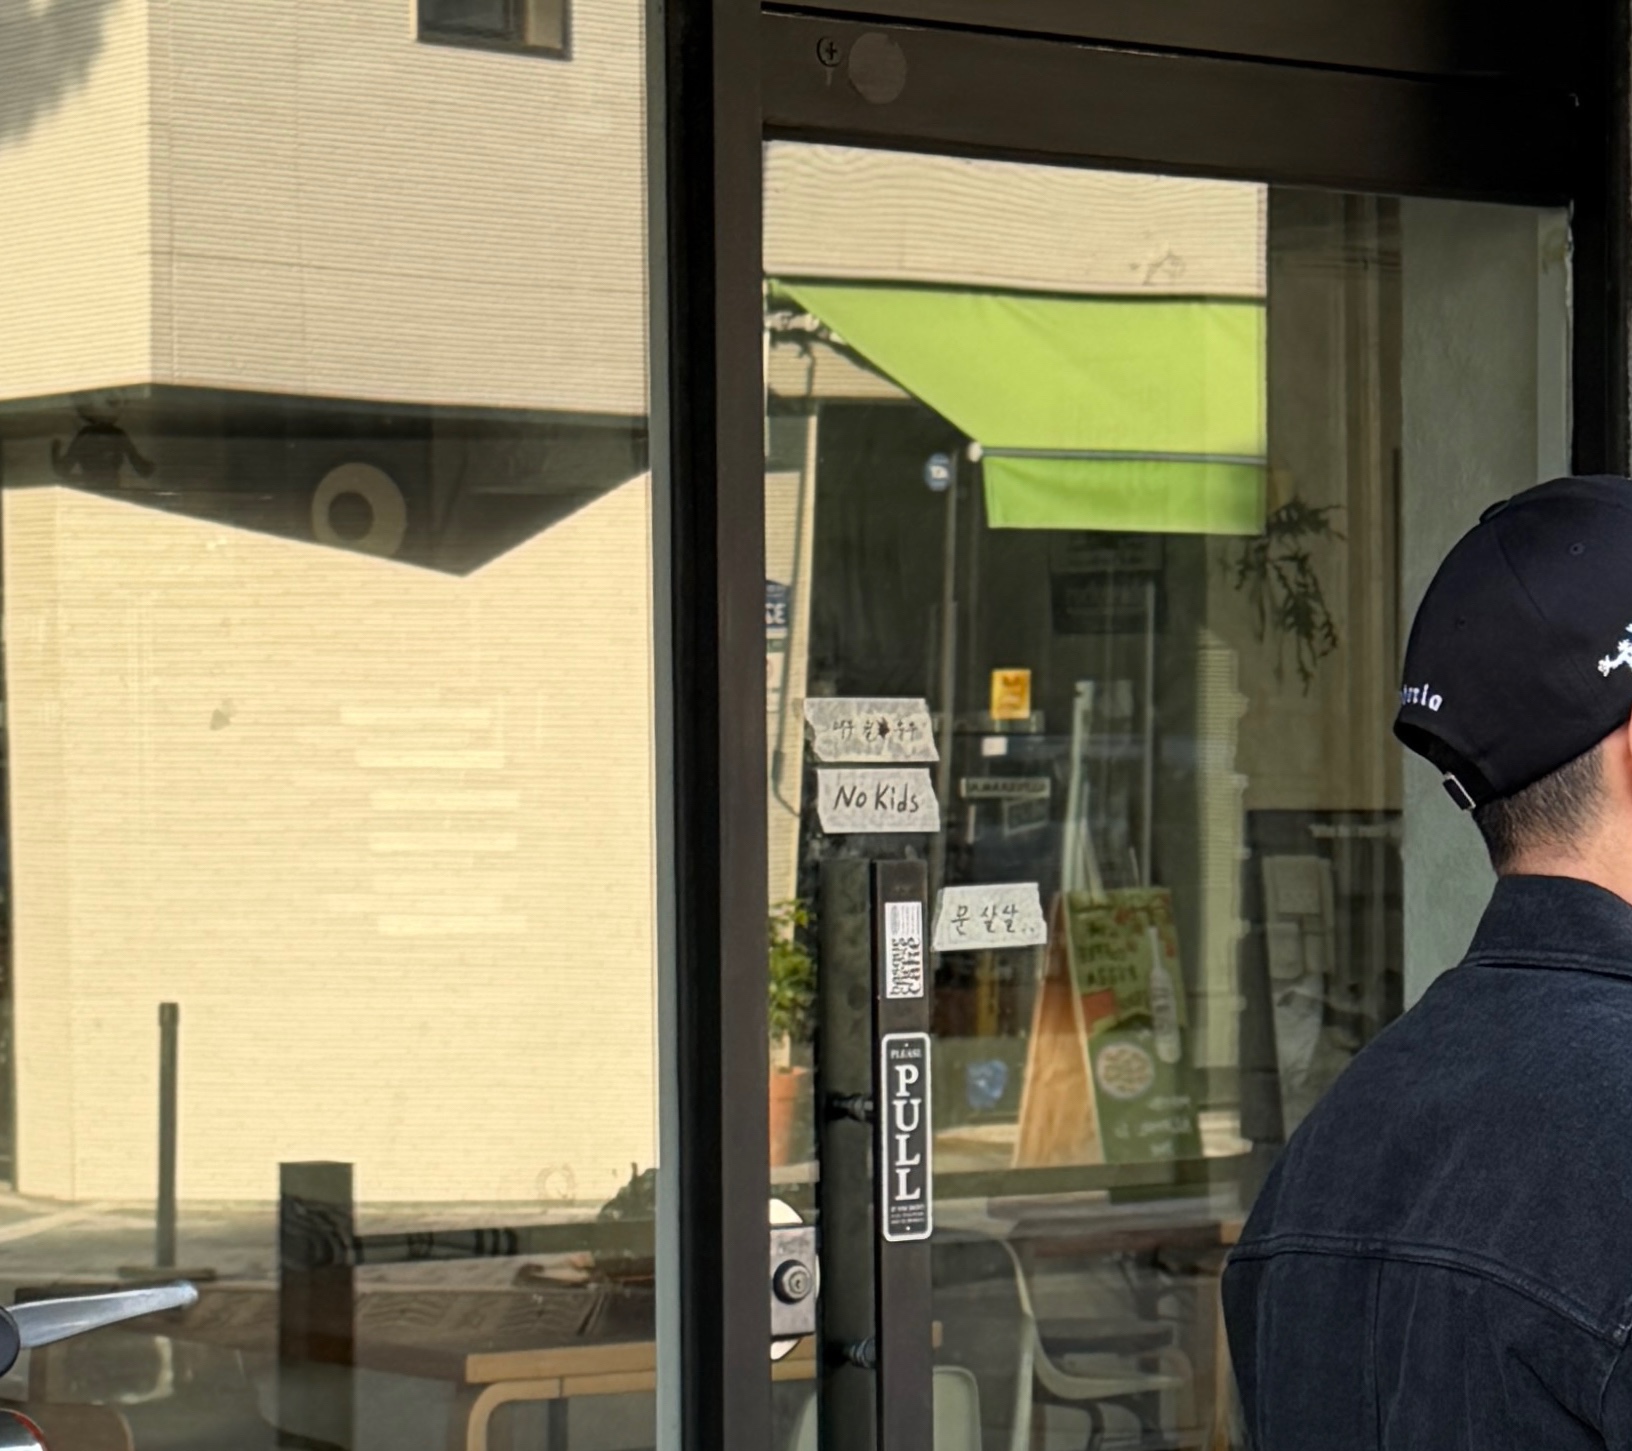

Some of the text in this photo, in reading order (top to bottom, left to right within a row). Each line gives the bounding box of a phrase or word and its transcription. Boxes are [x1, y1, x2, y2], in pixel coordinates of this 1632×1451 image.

[833, 783, 919, 813] No Kids
[951, 905, 970, 936] 문
[892, 1064, 922, 1201] PULL
